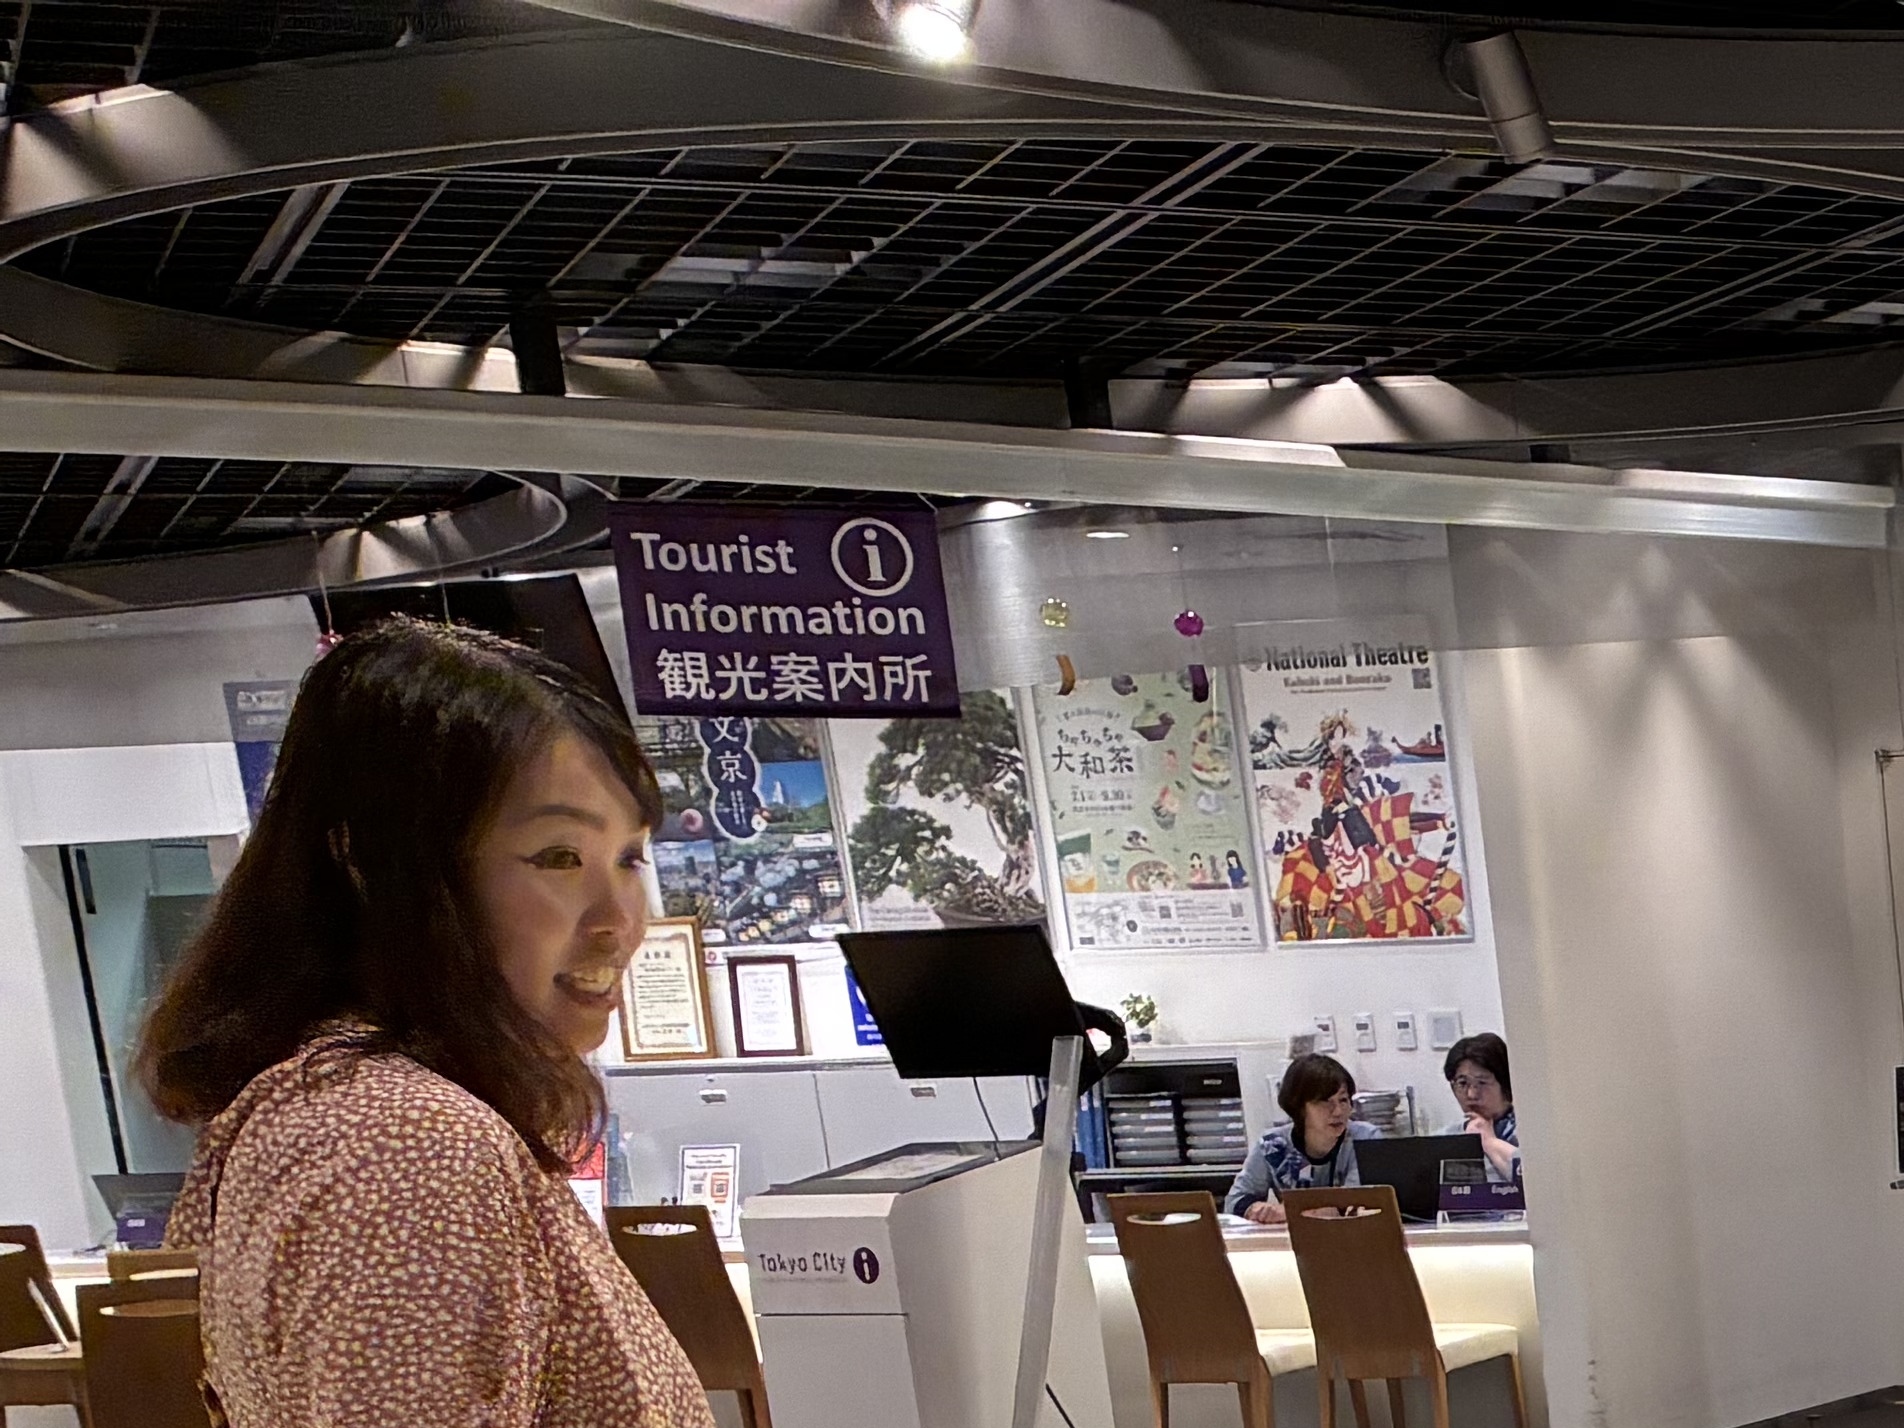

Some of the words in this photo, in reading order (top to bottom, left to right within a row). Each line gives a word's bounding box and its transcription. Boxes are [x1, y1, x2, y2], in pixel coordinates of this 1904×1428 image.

[630, 532, 798, 575] Tourist
[645, 593, 926, 635] Information
[656, 648, 933, 703] 観光案内所
[1265, 645, 1347, 671] National
[1351, 642, 1429, 667] Theatre
[1052, 745, 1134, 779] 大和茶
[758, 1253, 808, 1274] Tokyo
[813, 1252, 845, 1274] City
